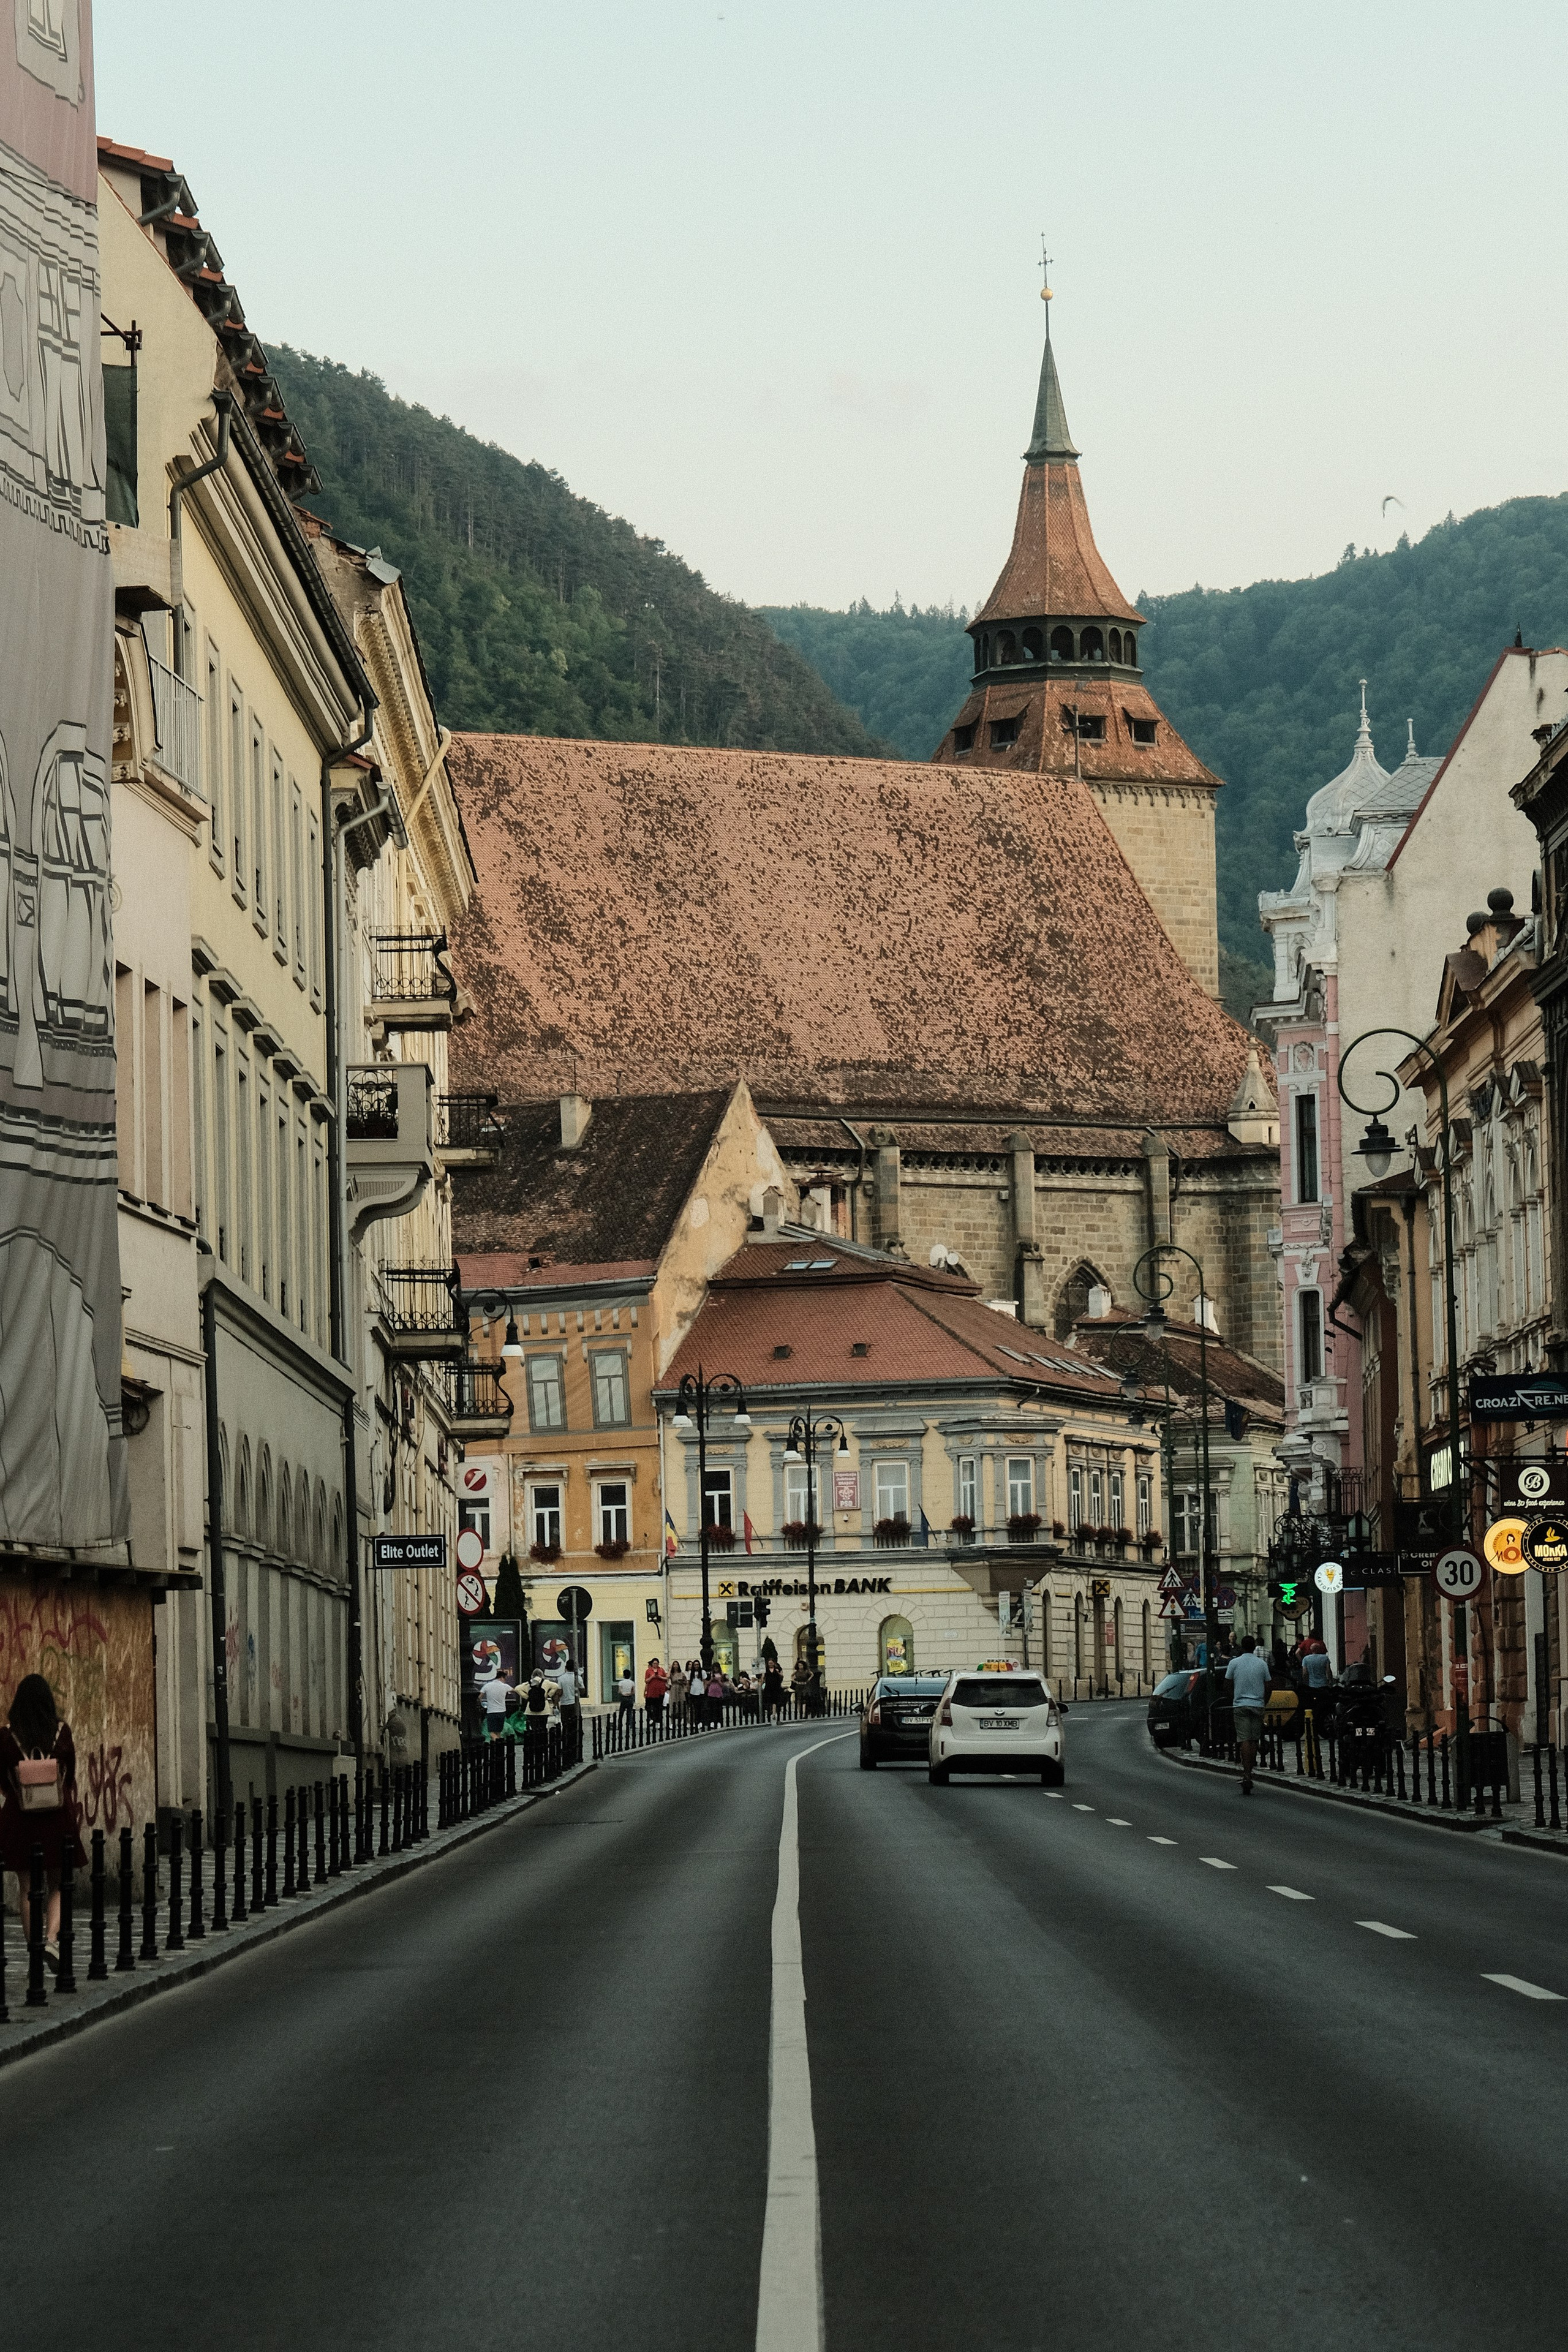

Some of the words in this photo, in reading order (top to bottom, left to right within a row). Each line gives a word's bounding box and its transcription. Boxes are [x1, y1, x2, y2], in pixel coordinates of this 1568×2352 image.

[381, 1544, 404, 1559] Elite
[406, 1544, 439, 1558] Outlet
[1445, 1560, 1474, 1586] 30
[834, 1577, 892, 1594] BANK
